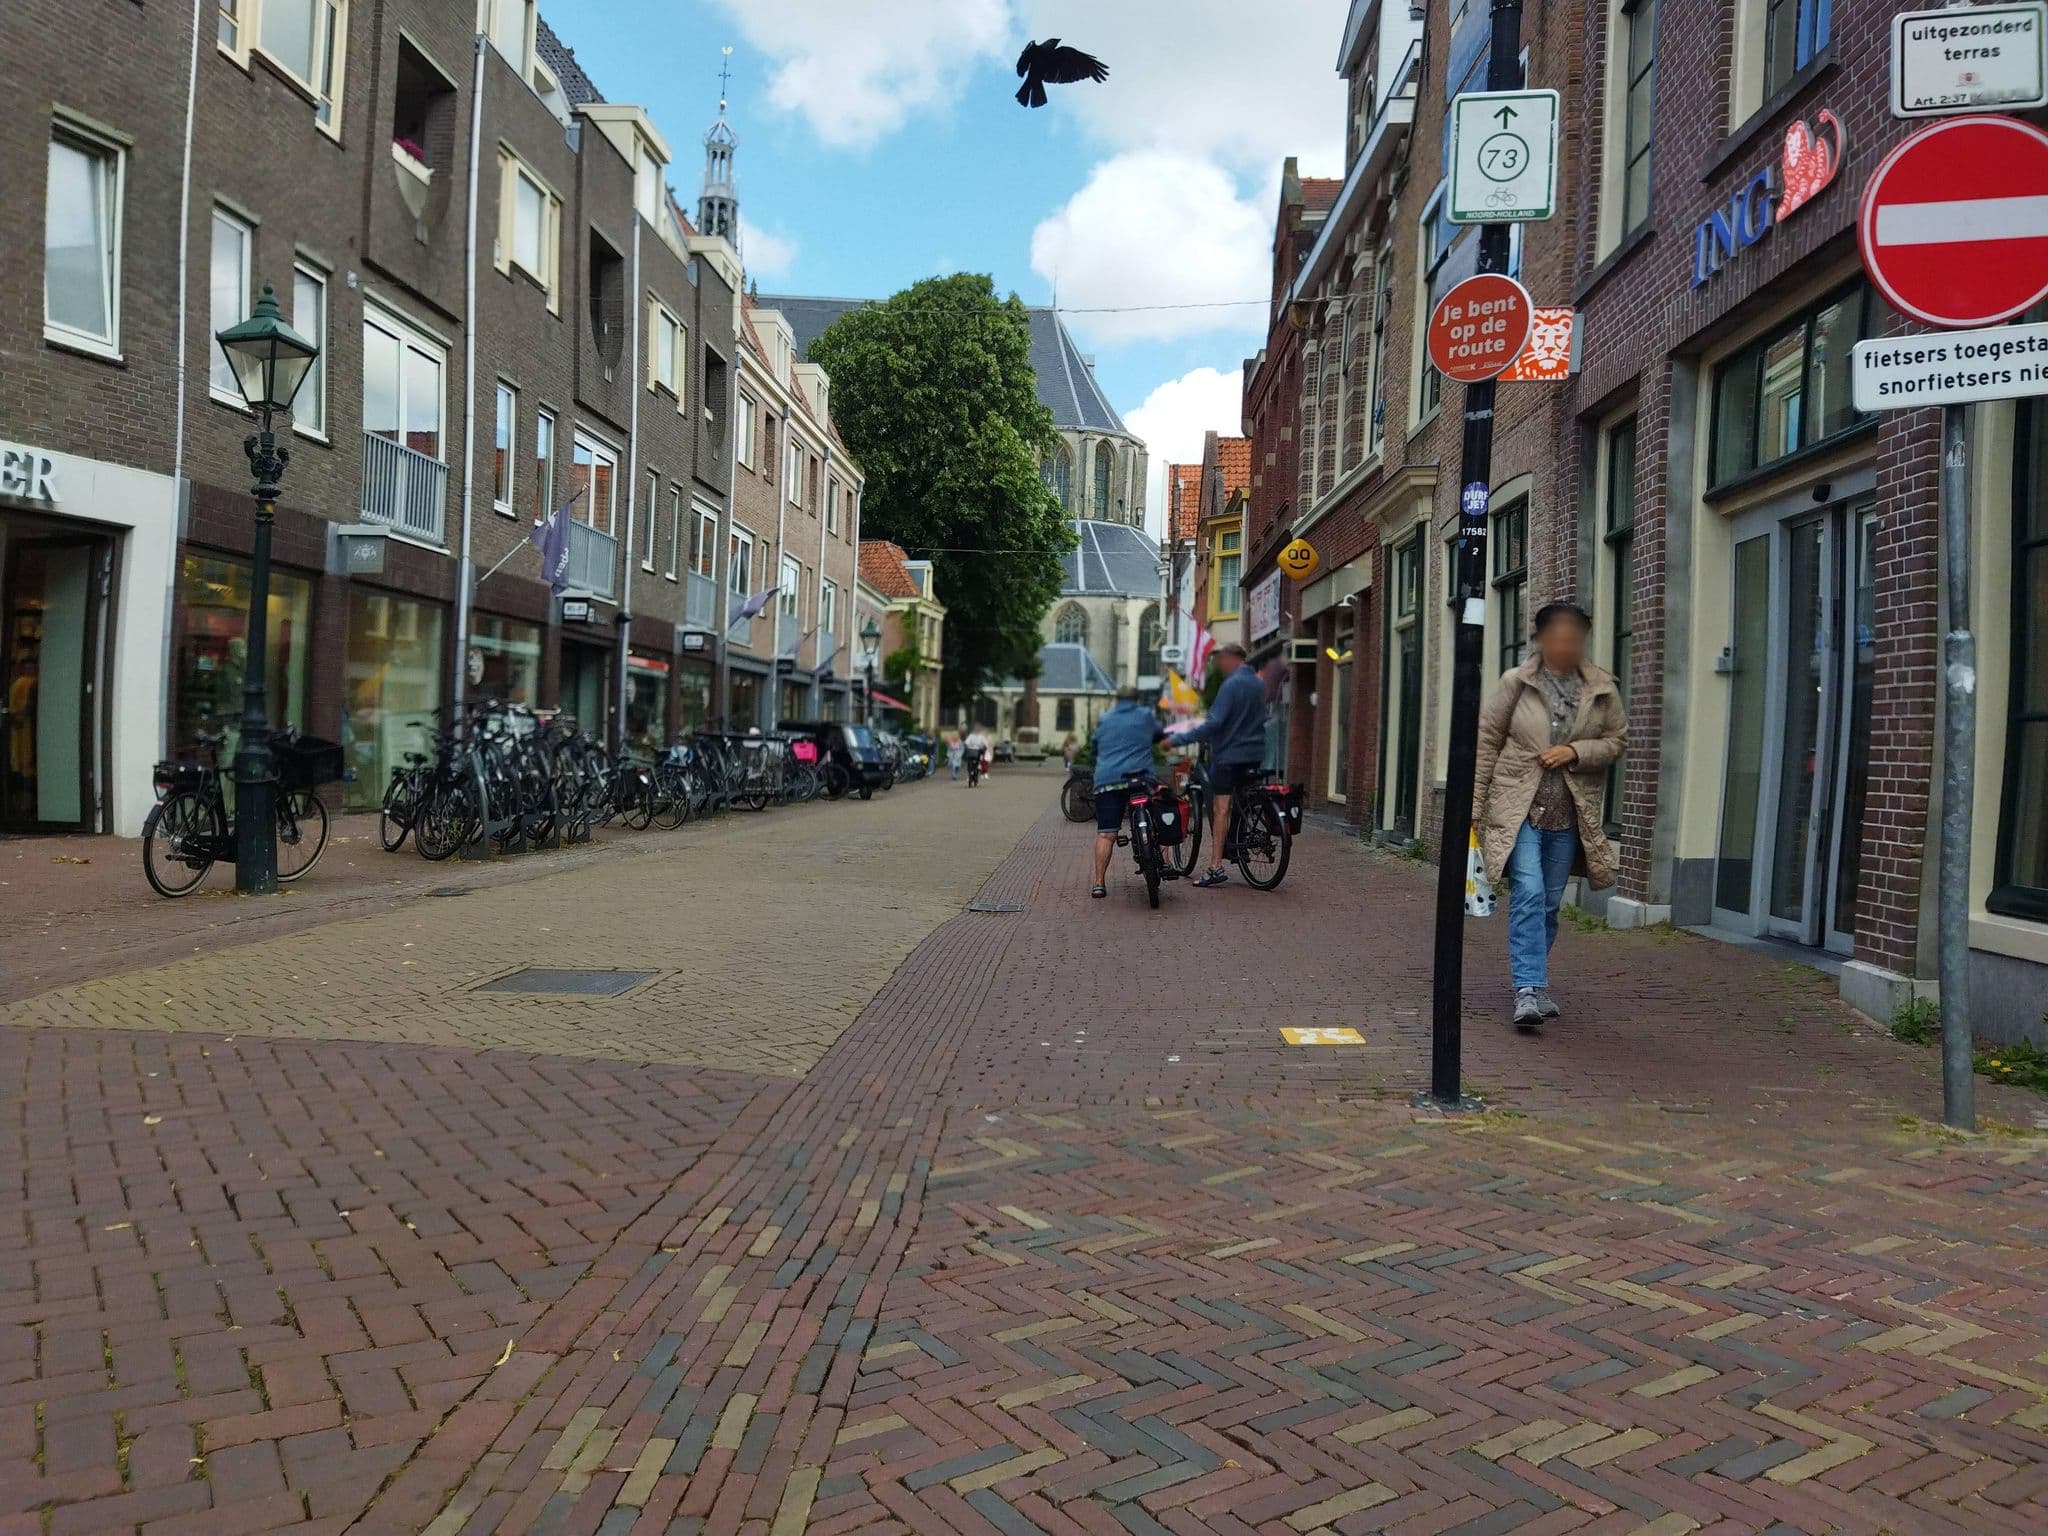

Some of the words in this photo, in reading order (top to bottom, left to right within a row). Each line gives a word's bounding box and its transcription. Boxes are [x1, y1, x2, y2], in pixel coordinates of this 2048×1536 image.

[1912, 19, 2033, 42] uitgezonderd
[1944, 46, 2001, 61] terras
[1914, 97, 1937, 107] Art.
[1486, 149, 1518, 169] 73
[1465, 210, 1536, 219] NOORD-HOLLAND
[1691, 164, 1775, 291] ING
[1440, 304, 1463, 327] Je
[1467, 295, 1517, 318] bent
[1450, 324, 1476, 343] op
[1481, 317, 1507, 335] de
[1448, 338, 1506, 359] route
[1864, 348, 1947, 369] fietsers
[1954, 336, 2048, 361] toegesta
[1878, 370, 2012, 395] snorfietsers
[1463, 490, 1488, 501] DURF
[1467, 500, 1485, 510] JE?
[1462, 527, 1487, 536] 17582
[1472, 547, 1479, 555] 2
